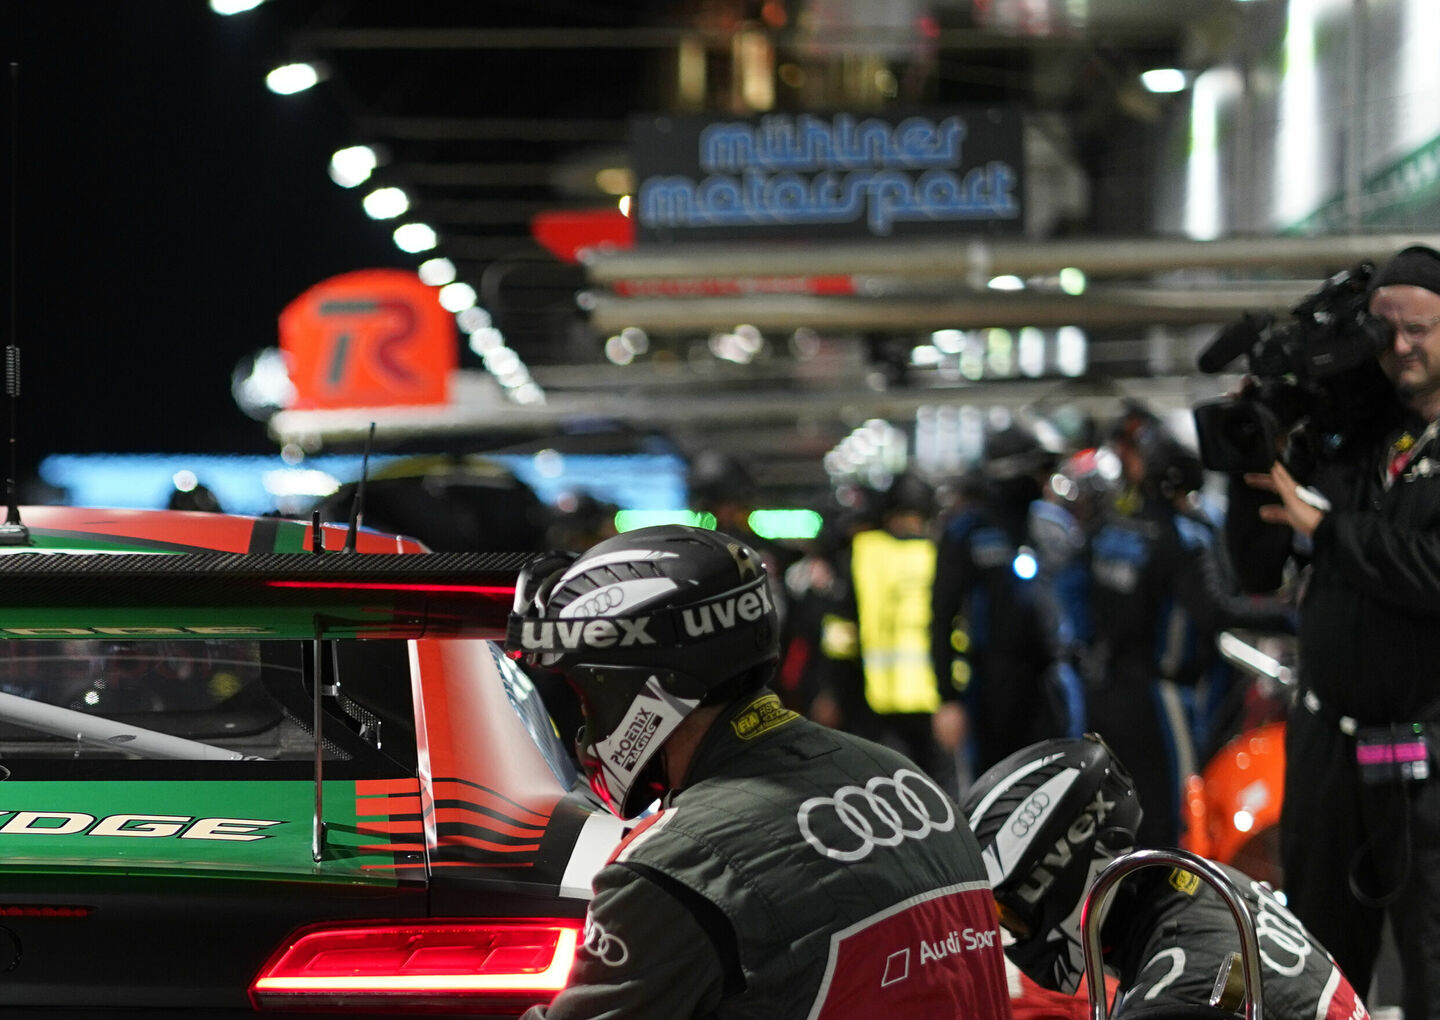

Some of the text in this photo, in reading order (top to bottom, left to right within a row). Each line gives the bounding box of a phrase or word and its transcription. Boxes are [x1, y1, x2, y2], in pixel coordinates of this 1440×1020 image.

[700, 113, 967, 172] mühlner
[638, 160, 1019, 236] motorsport
[521, 616, 656, 650] uvex
[682, 585, 772, 638] uvex
[1017, 790, 1115, 904] uvex
[921, 928, 997, 965] Audi Spor
